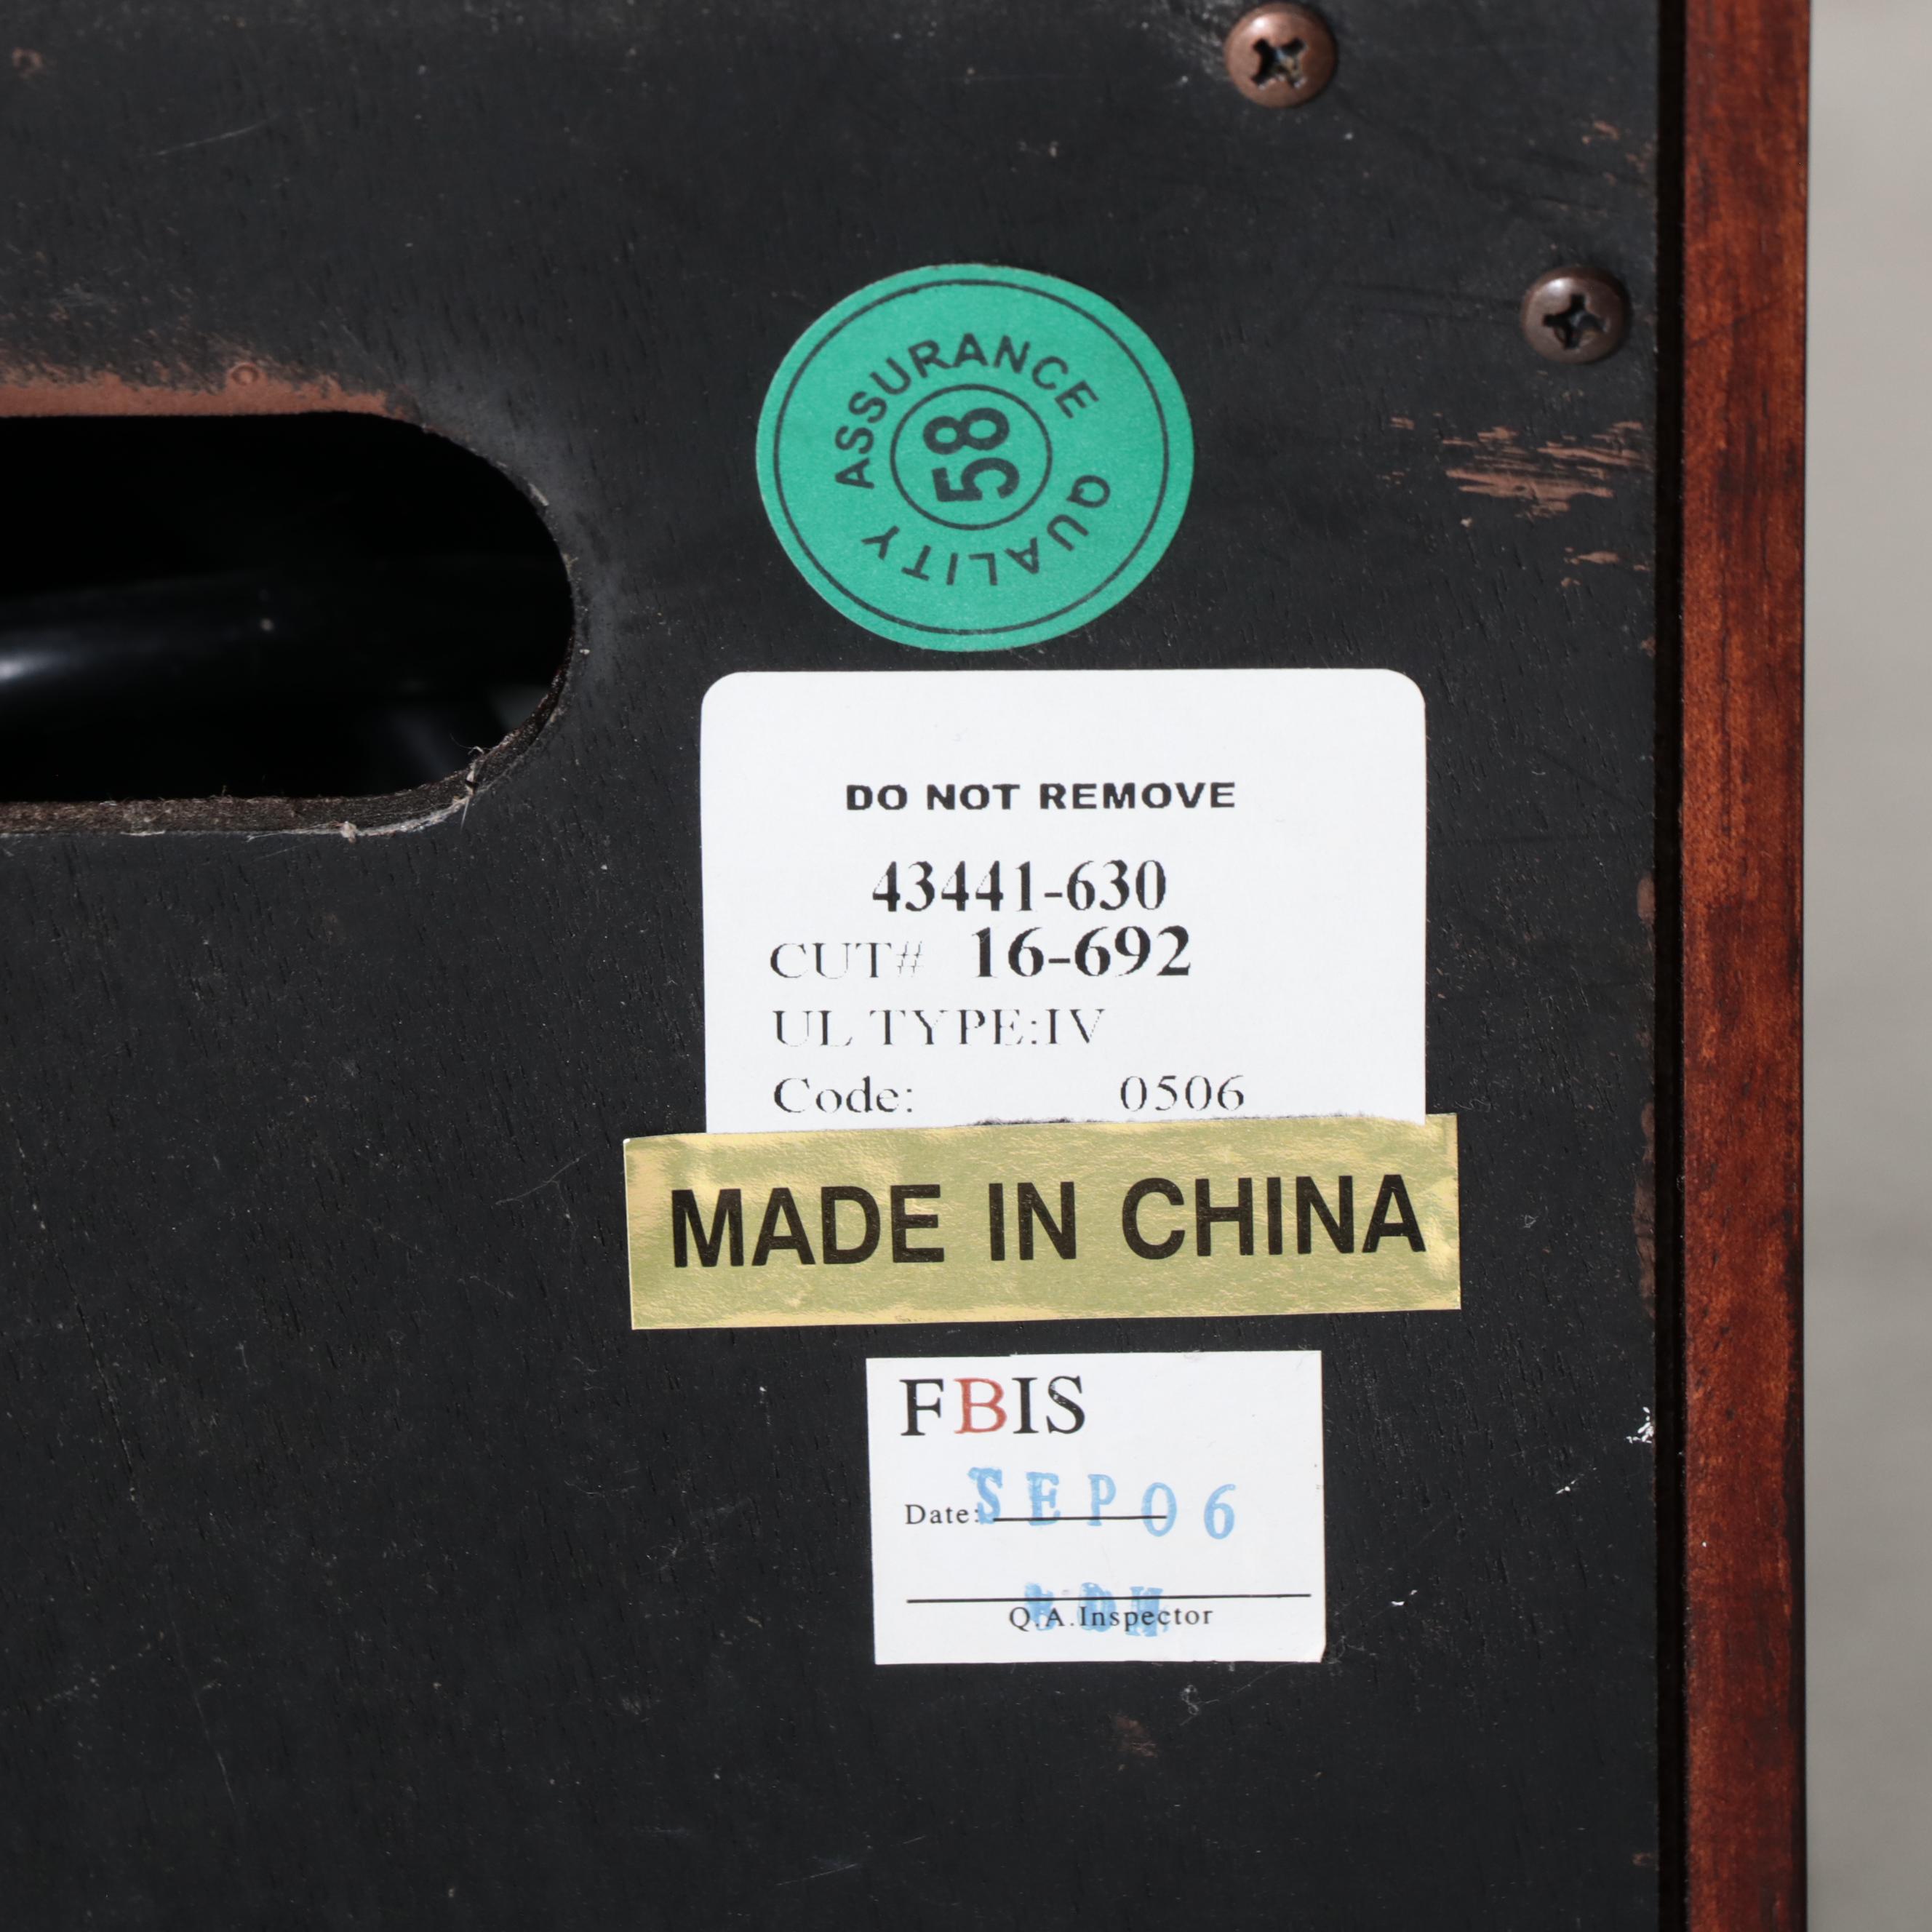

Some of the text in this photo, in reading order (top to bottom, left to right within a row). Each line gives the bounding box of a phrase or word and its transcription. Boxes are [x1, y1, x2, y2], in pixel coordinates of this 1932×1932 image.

[834, 332, 1111, 586] QUALITY ASSURANCE
[922, 407, 1020, 502] 58
[846, 781, 1236, 811] DO NOT REMOVE
[872, 859, 1167, 912] 43441-630
[770, 925, 1191, 979] CUT# 16-692
[773, 1009, 1106, 1047] UL TYPE:IV
[773, 1075, 1245, 1114] Code: 0506
[671, 1174, 1426, 1268] MADE IN CHINA
[900, 1376, 1087, 1437] FBIS
[905, 1504, 978, 1525] Date:
